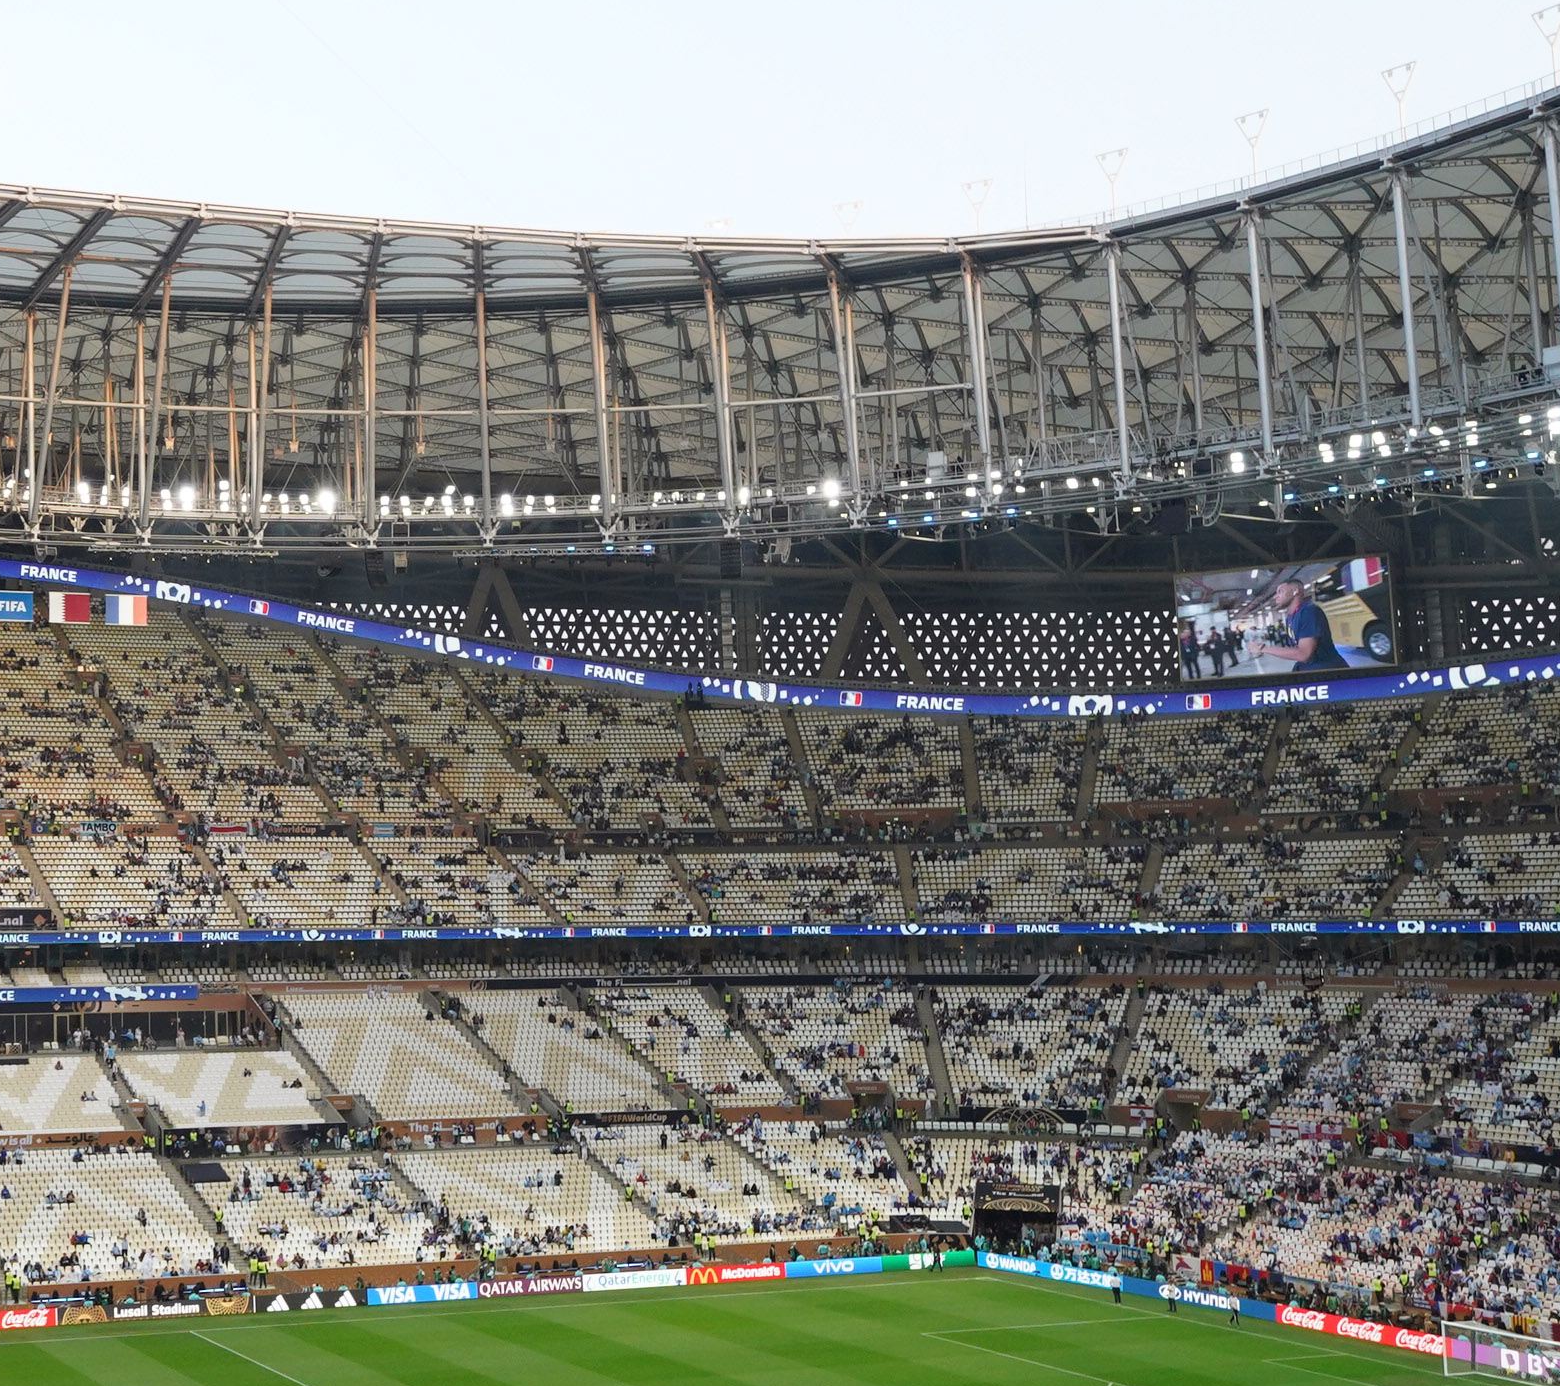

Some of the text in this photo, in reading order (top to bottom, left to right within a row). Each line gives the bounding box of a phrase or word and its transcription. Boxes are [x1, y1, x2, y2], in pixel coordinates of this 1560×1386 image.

[21, 565, 77, 582] FRANCE
[298, 611, 354, 632] FRANCE
[585, 664, 644, 685] FRANCE
[897, 695, 964, 710] FRANCE
[1252, 685, 1328, 705] FRANCE
[80, 823, 117, 834] TAMBO
[402, 930, 437, 938] FRANCE
[592, 928, 626, 936] FRANCE
[792, 926, 831, 934] FRANCE
[1017, 924, 1059, 933] FRANCE
[1271, 923, 1316, 931] FRANCE
[202, 932, 239, 940] FRANCE
[813, 1258, 855, 1275] vivo
[999, 1255, 1037, 1273] WANDA
[598, 1270, 672, 1290] QatarEnergy
[721, 1266, 781, 1282] McDonald's
[376, 1286, 417, 1304] VISA
[430, 1283, 471, 1301] VISA
[479, 1276, 582, 1298] QATAR AIRWAYS
[1184, 1289, 1240, 1311] HYUNDI
[114, 1302, 201, 1319] Lusail Stadium
